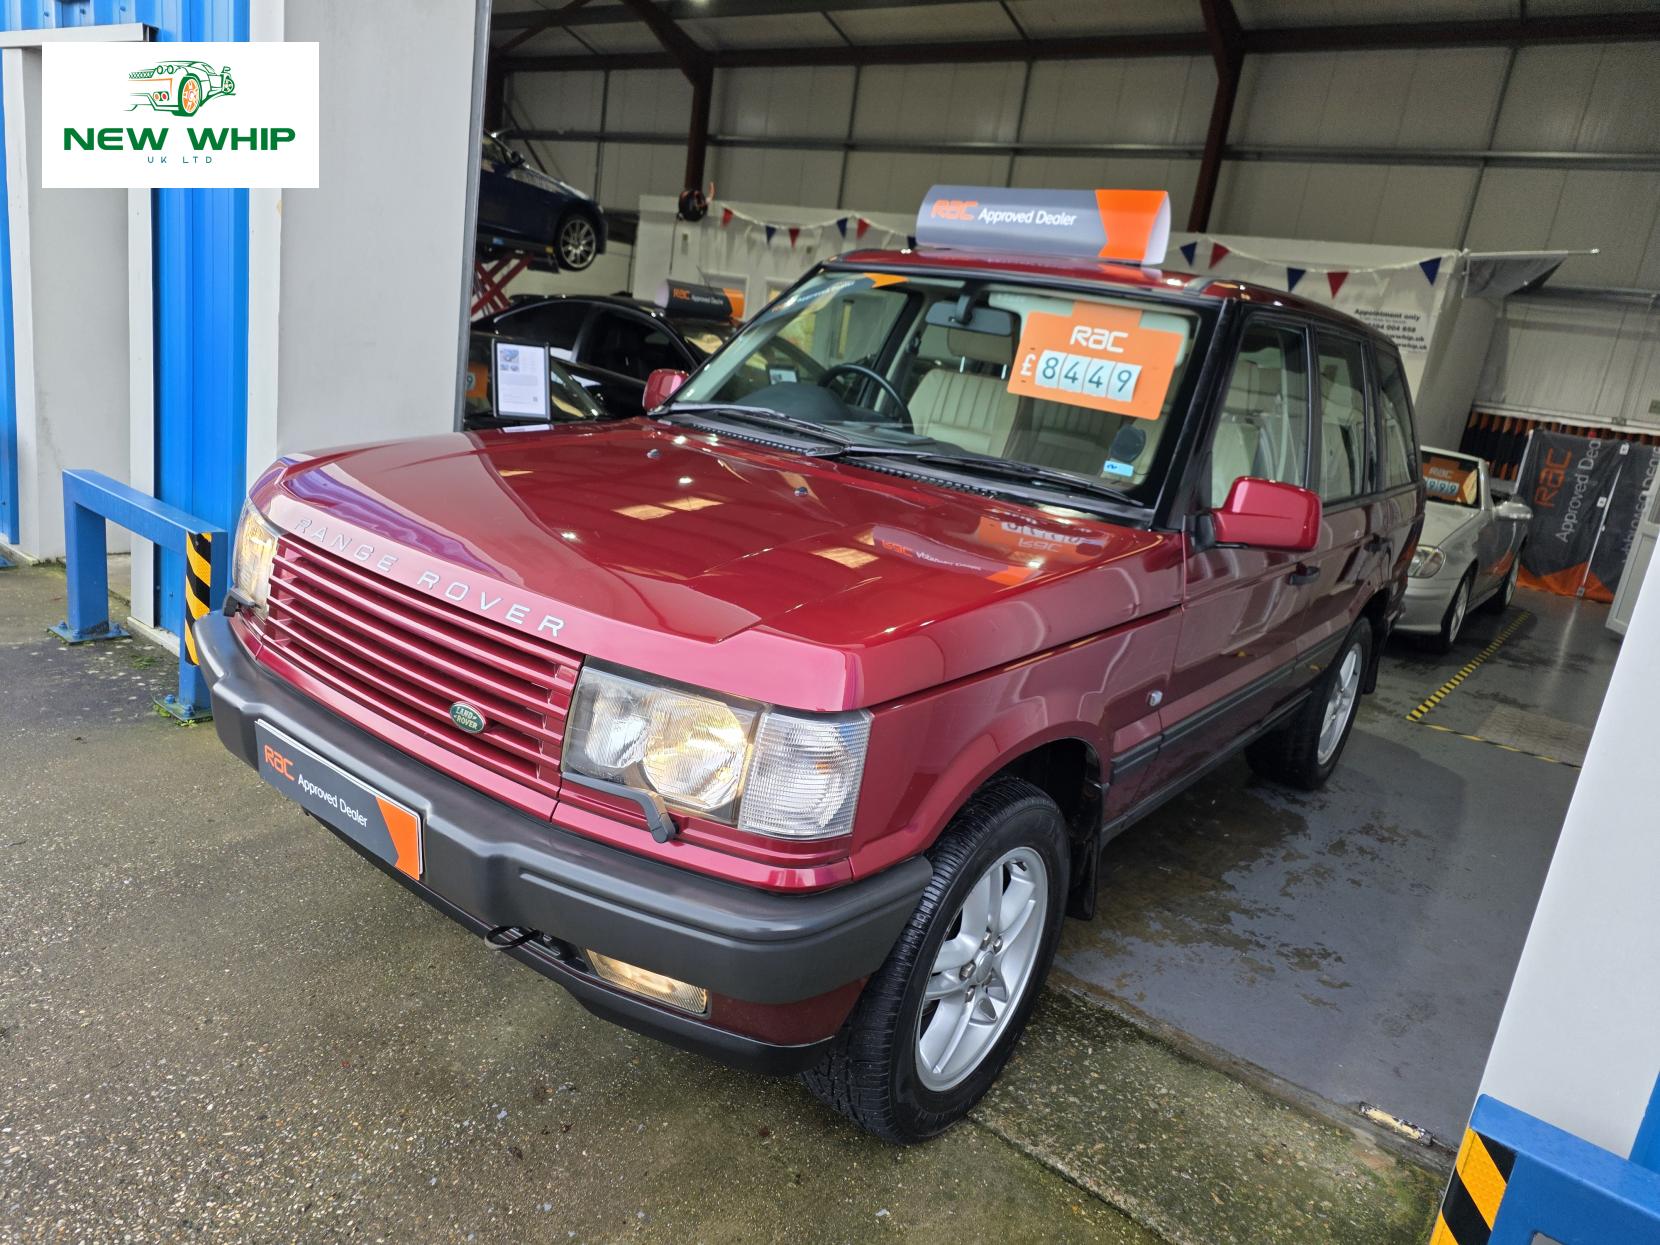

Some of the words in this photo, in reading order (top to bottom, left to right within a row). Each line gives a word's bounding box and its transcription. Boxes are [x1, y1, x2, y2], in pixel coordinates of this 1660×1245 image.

[978, 208, 1035, 224] Approved
[1035, 210, 1078, 226] Dealer
[1555, 473, 1590, 543] Approved
[294, 519, 398, 572] RANGE
[416, 571, 565, 637] ROVER
[456, 706, 474, 719] LAND
[457, 714, 478, 730] ROVER
[298, 773, 338, 808] Approved
[339, 798, 368, 828] Dealer
